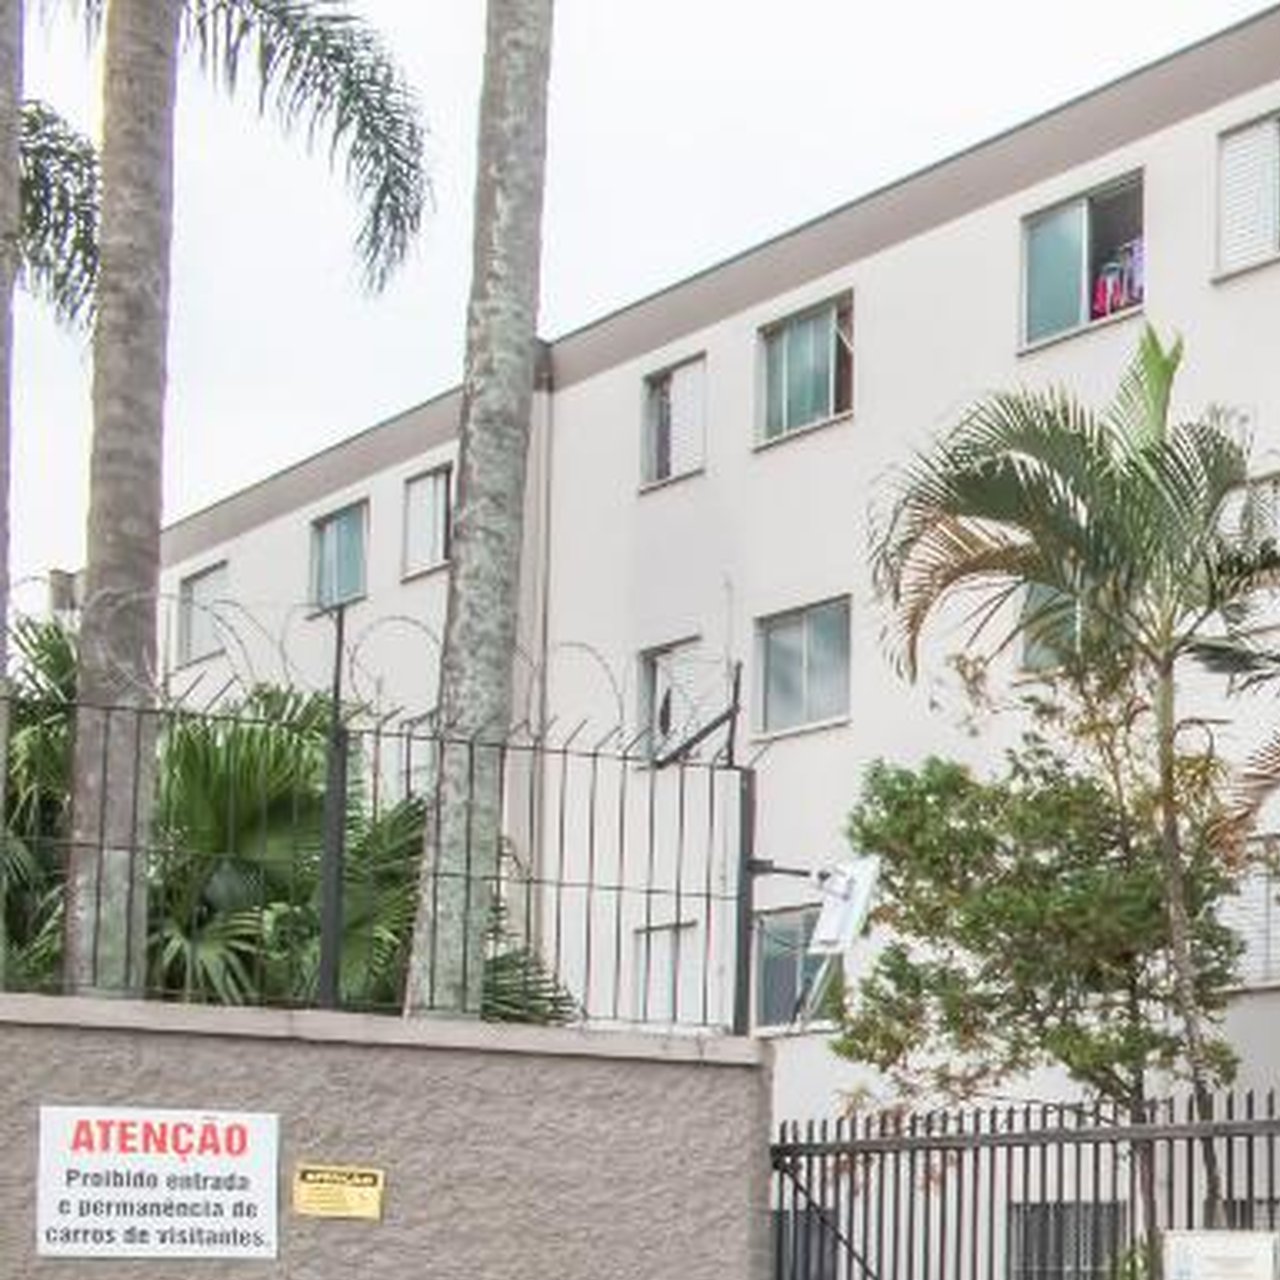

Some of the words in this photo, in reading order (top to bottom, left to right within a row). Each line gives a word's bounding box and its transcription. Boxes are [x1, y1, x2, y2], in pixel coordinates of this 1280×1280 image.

[71, 1115, 249, 1162] ATENÇÃO
[66, 1169, 158, 1189] Proibido
[166, 1172, 249, 1191] entrada
[79, 1199, 224, 1218] permanência
[232, 1201, 258, 1218] de
[46, 1227, 116, 1244] carros
[123, 1226, 150, 1244] de
